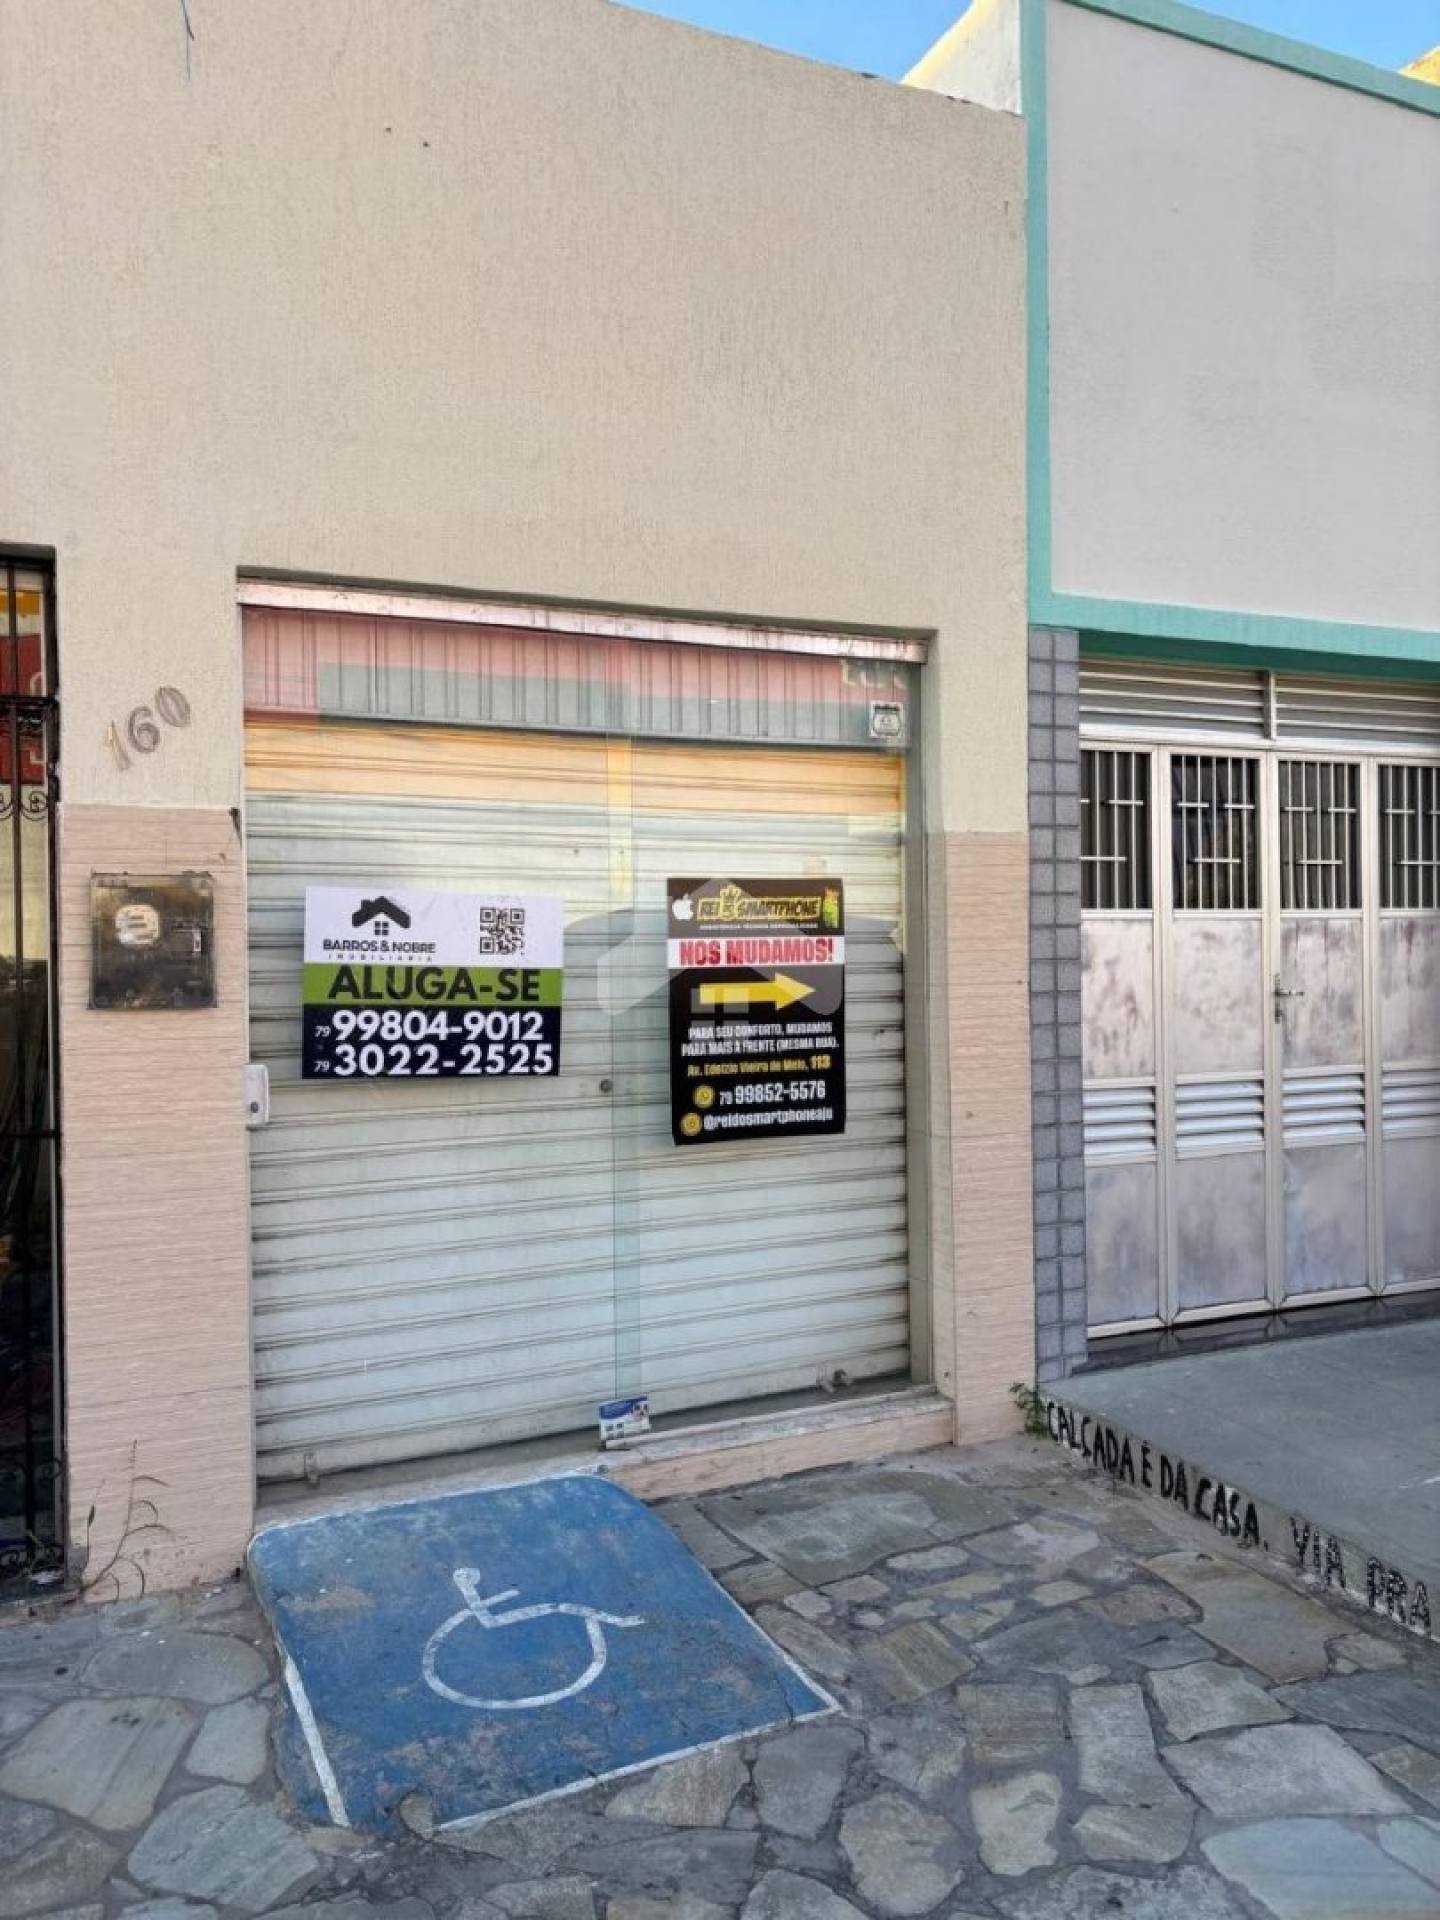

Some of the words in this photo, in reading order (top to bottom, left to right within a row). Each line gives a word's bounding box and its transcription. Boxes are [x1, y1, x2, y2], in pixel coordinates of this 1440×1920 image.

[105, 686, 191, 770] 160
[322, 939, 378, 951] BARROS
[380, 940, 390, 951] &
[392, 942, 436, 953] NOBRE
[679, 940, 720, 965] NOS
[726, 938, 833, 964] MUDAMOS!
[327, 964, 540, 1001] ALUGA-SE
[314, 1026, 331, 1038] 79
[332, 1009, 543, 1041] 99804-9012
[688, 1027, 714, 1039] PARA
[716, 1026, 733, 1038] SEU
[786, 1021, 832, 1034] MUDAMOS
[314, 1060, 330, 1072] 79
[334, 1043, 552, 1076] 3022-2525
[681, 1043, 706, 1056] PARA
[708, 1041, 733, 1055] MAIS
[743, 1038, 775, 1053] FRENTE
[777, 1037, 814, 1051] (MESMA
[720, 1092, 732, 1105] 79
[735, 1080, 826, 1104] 99852-5576
[703, 1107, 833, 1131] @reidosmartphoneaju
[1047, 1401, 1135, 1485] CALÇADA
[1160, 1454, 1188, 1511] DA
[1290, 1516, 1346, 1590] VIA
[1366, 1557, 1433, 1638] PRA
